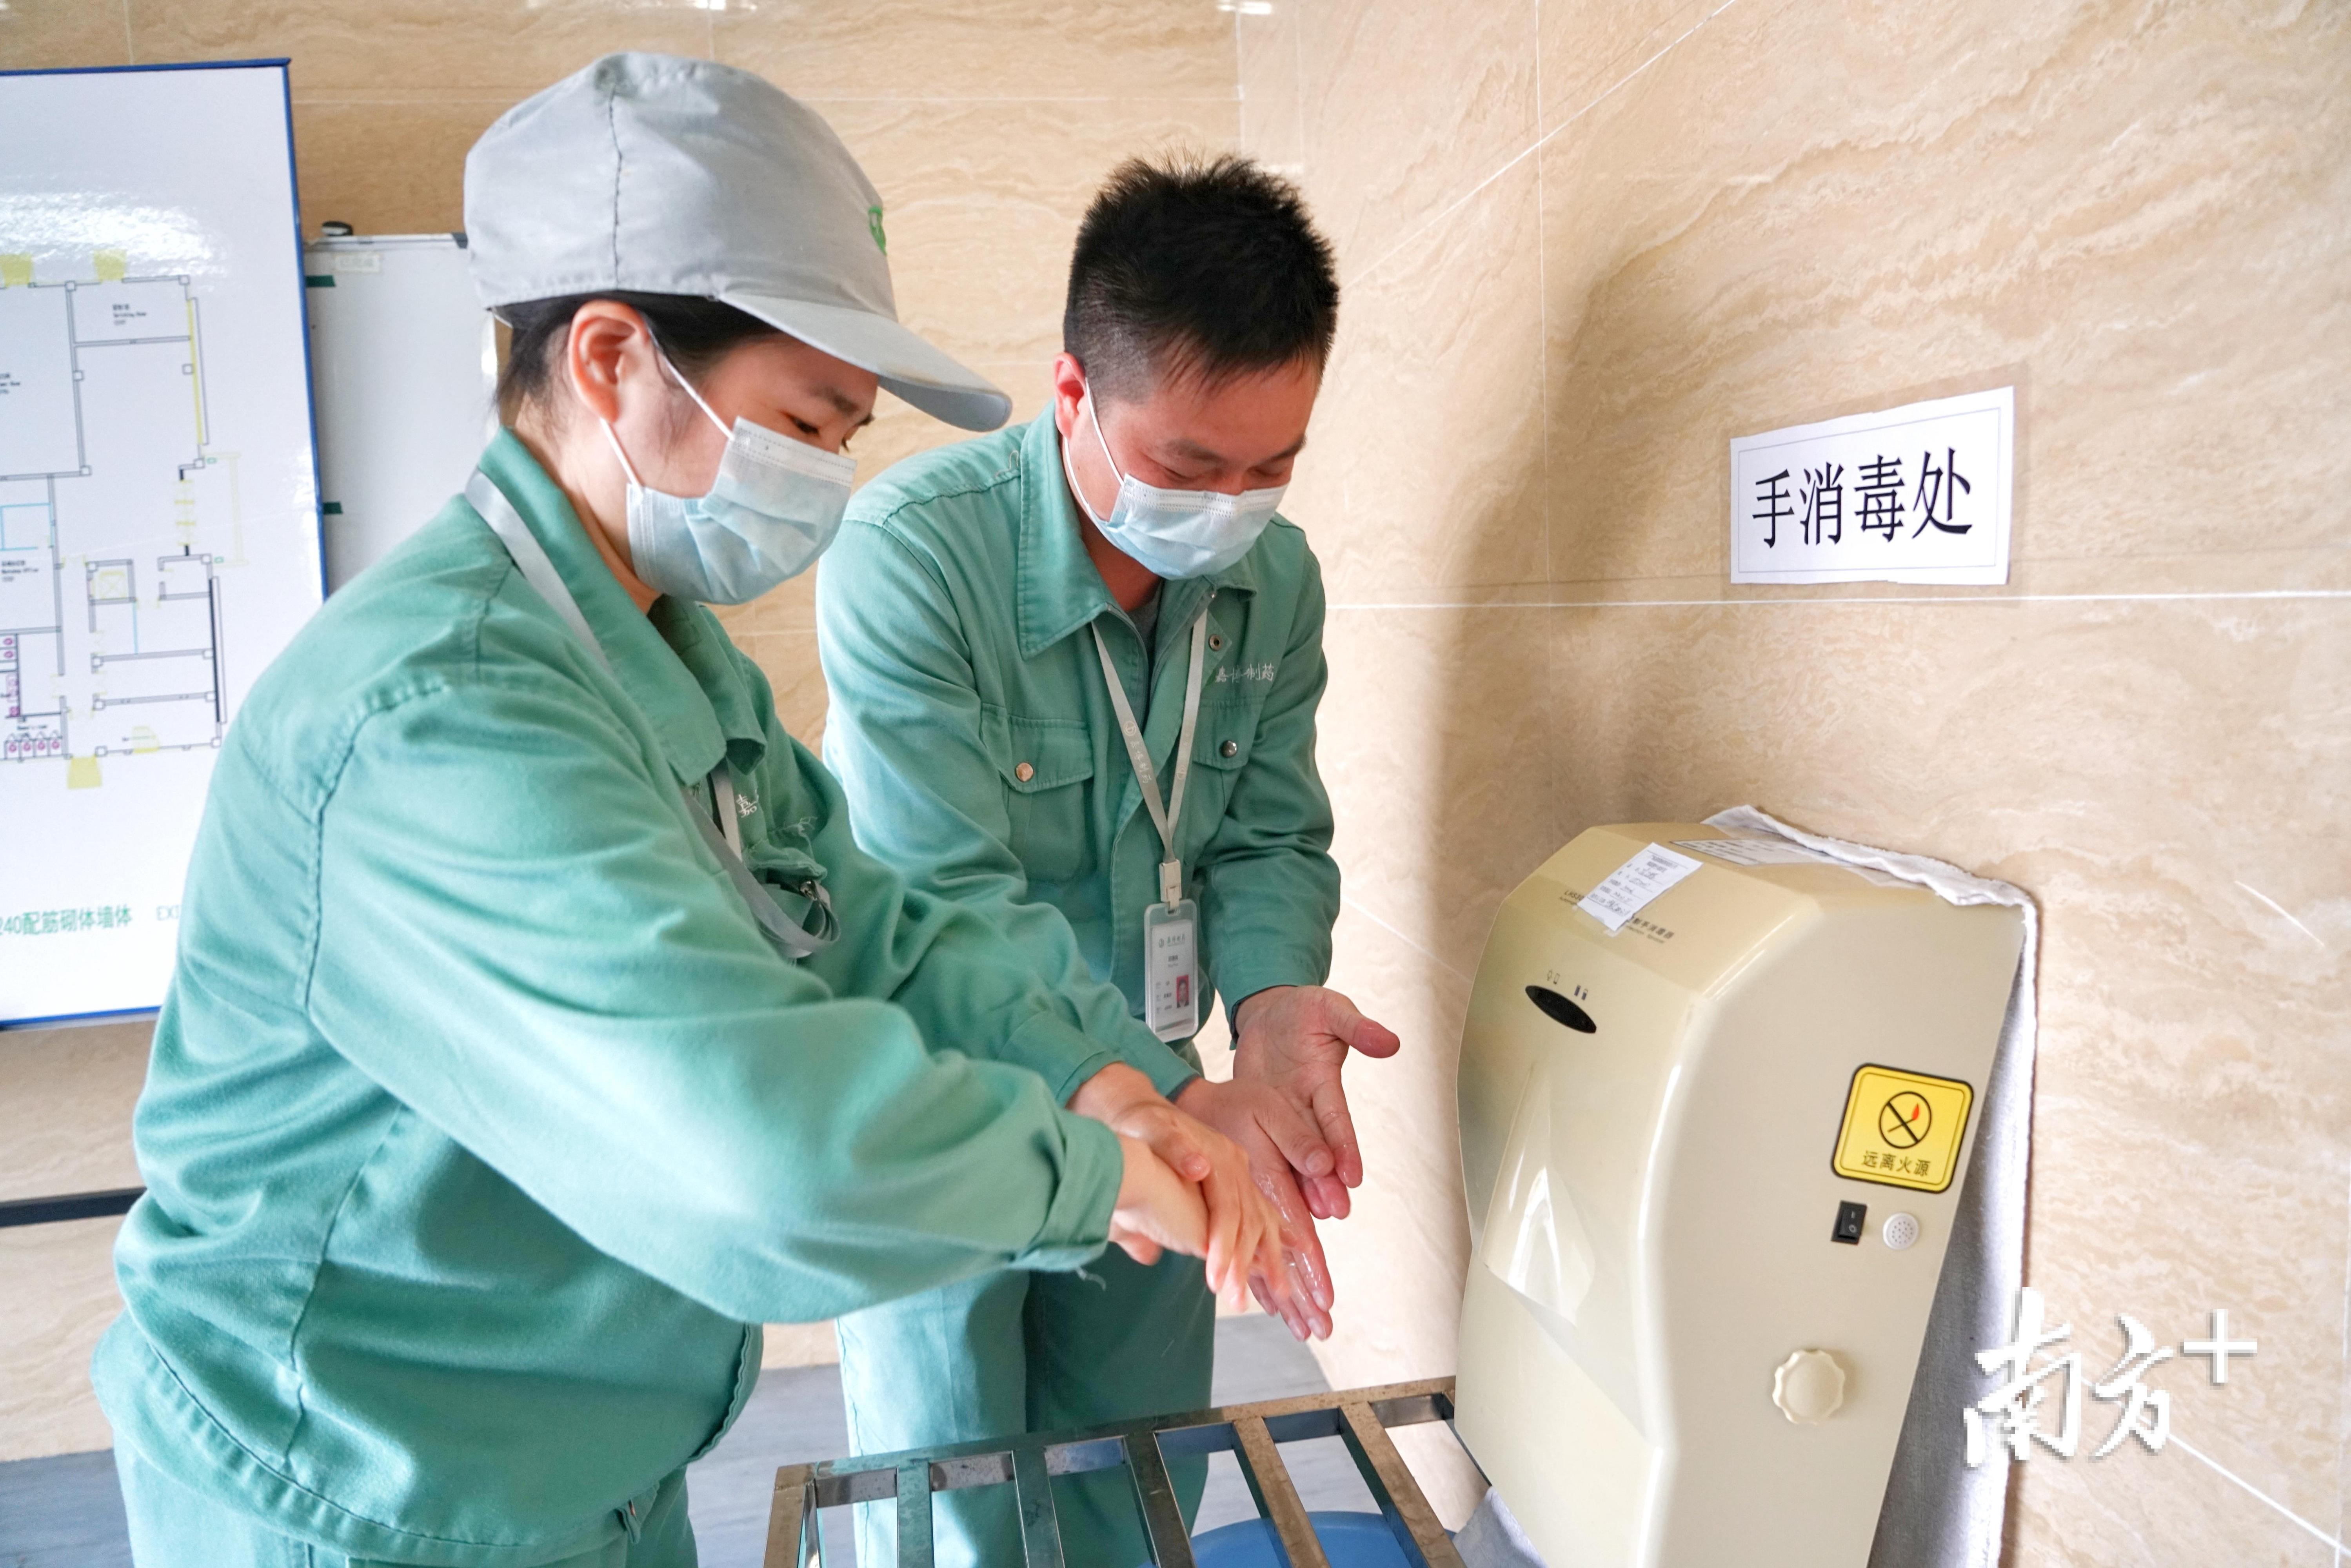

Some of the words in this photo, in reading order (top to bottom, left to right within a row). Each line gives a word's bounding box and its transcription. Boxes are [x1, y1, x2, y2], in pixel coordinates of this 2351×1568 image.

[1752, 447, 1972, 548] 手消毒处
[1862, 1151, 1931, 1177] 远离火源
